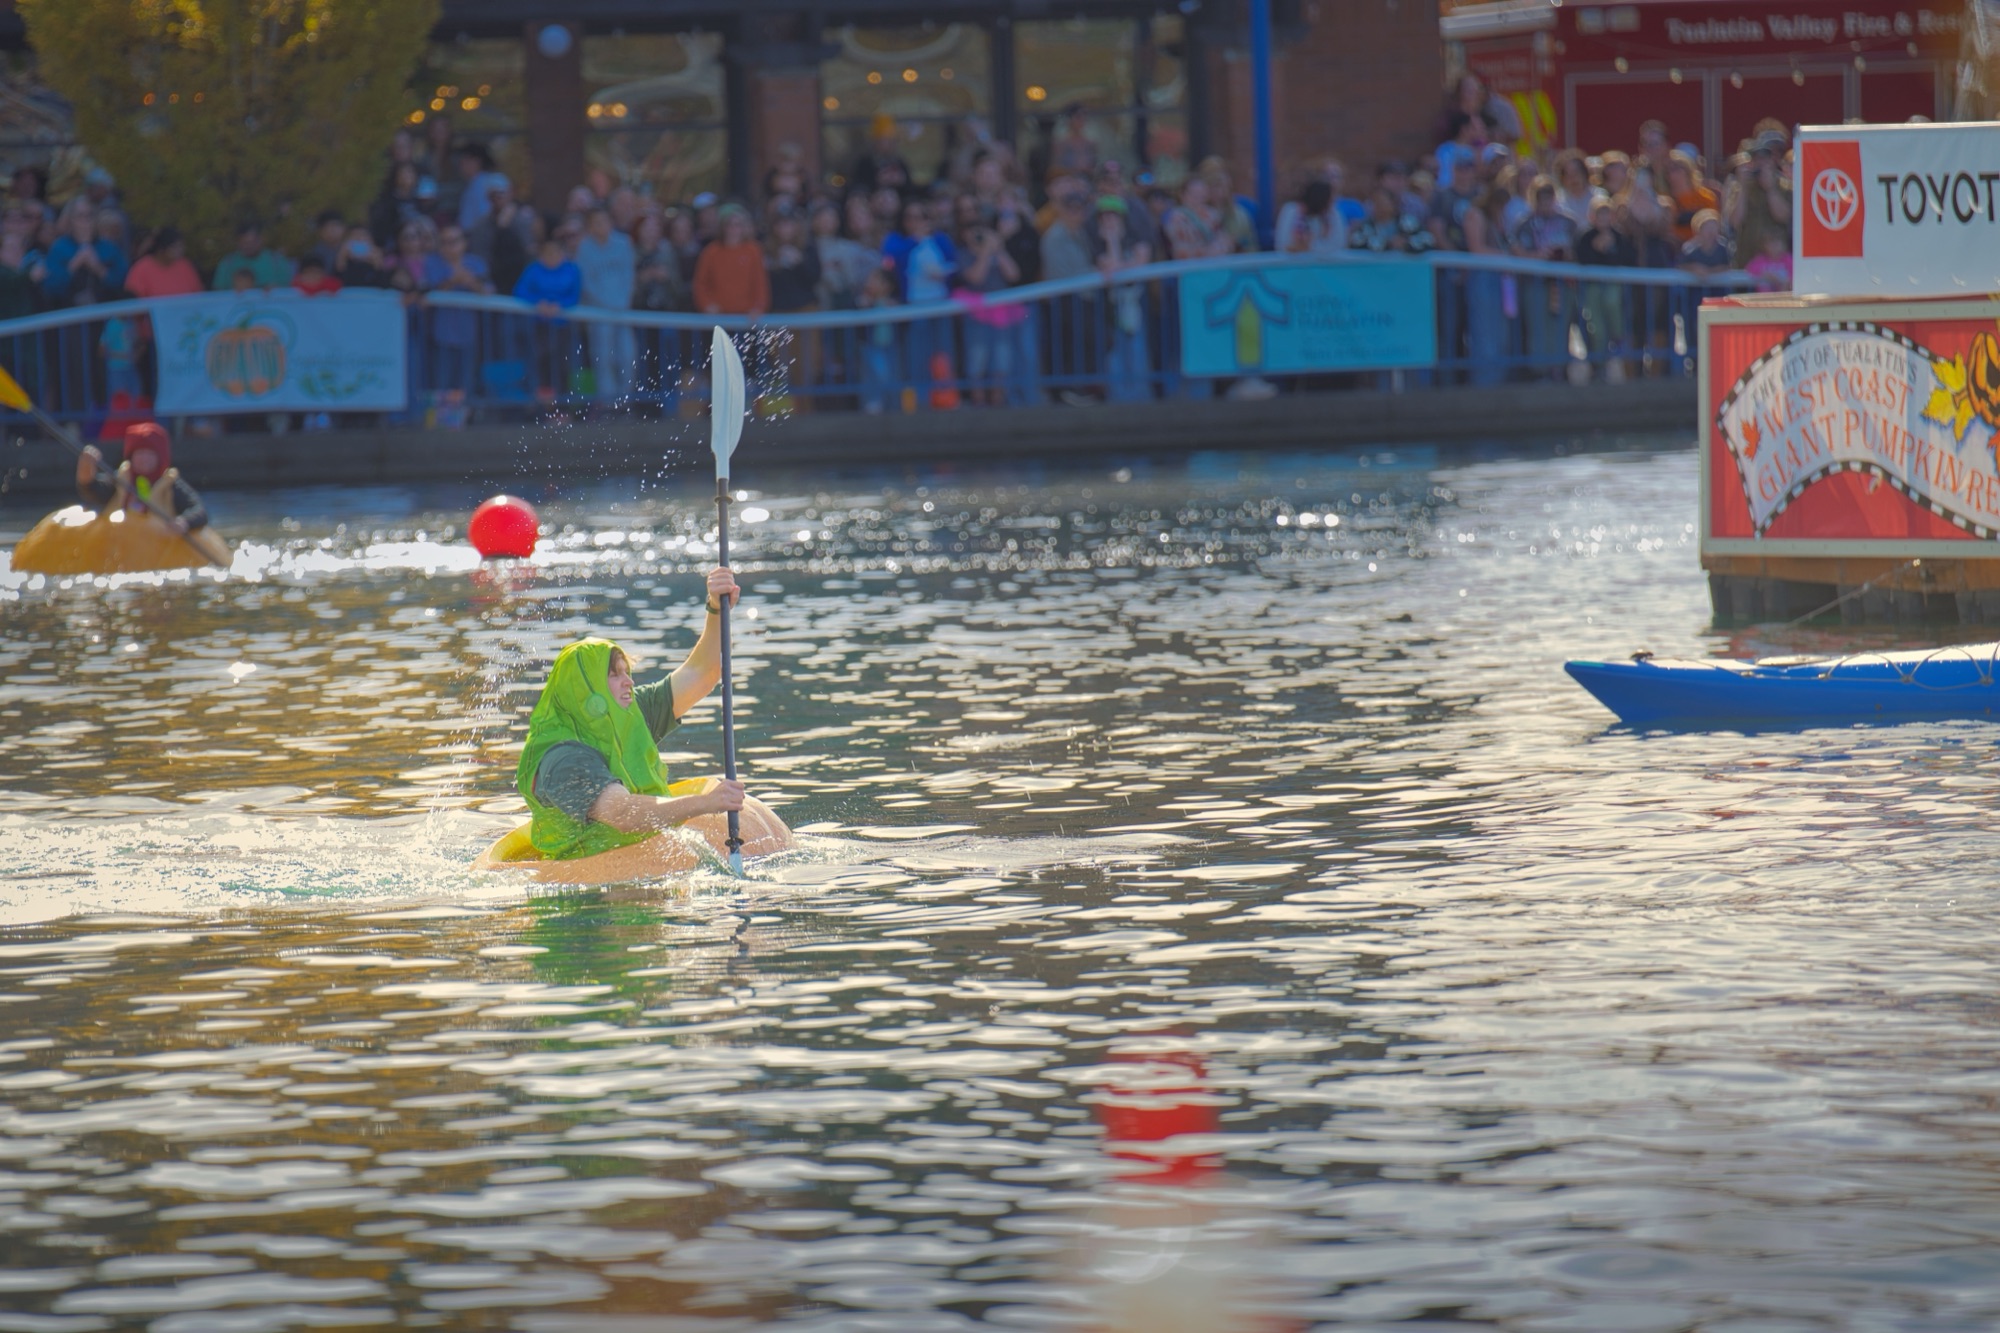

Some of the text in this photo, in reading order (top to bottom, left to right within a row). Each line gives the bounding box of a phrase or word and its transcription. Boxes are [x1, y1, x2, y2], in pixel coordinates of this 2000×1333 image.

[1767, 14, 1838, 43] Valley
[1877, 170, 2000, 224] TOYOT
[1813, 344, 1829, 368] OF
[1763, 366, 1914, 439] WEST COAST
[1758, 411, 1837, 502] GIANT
[1844, 409, 1964, 494] PUMPKIN
